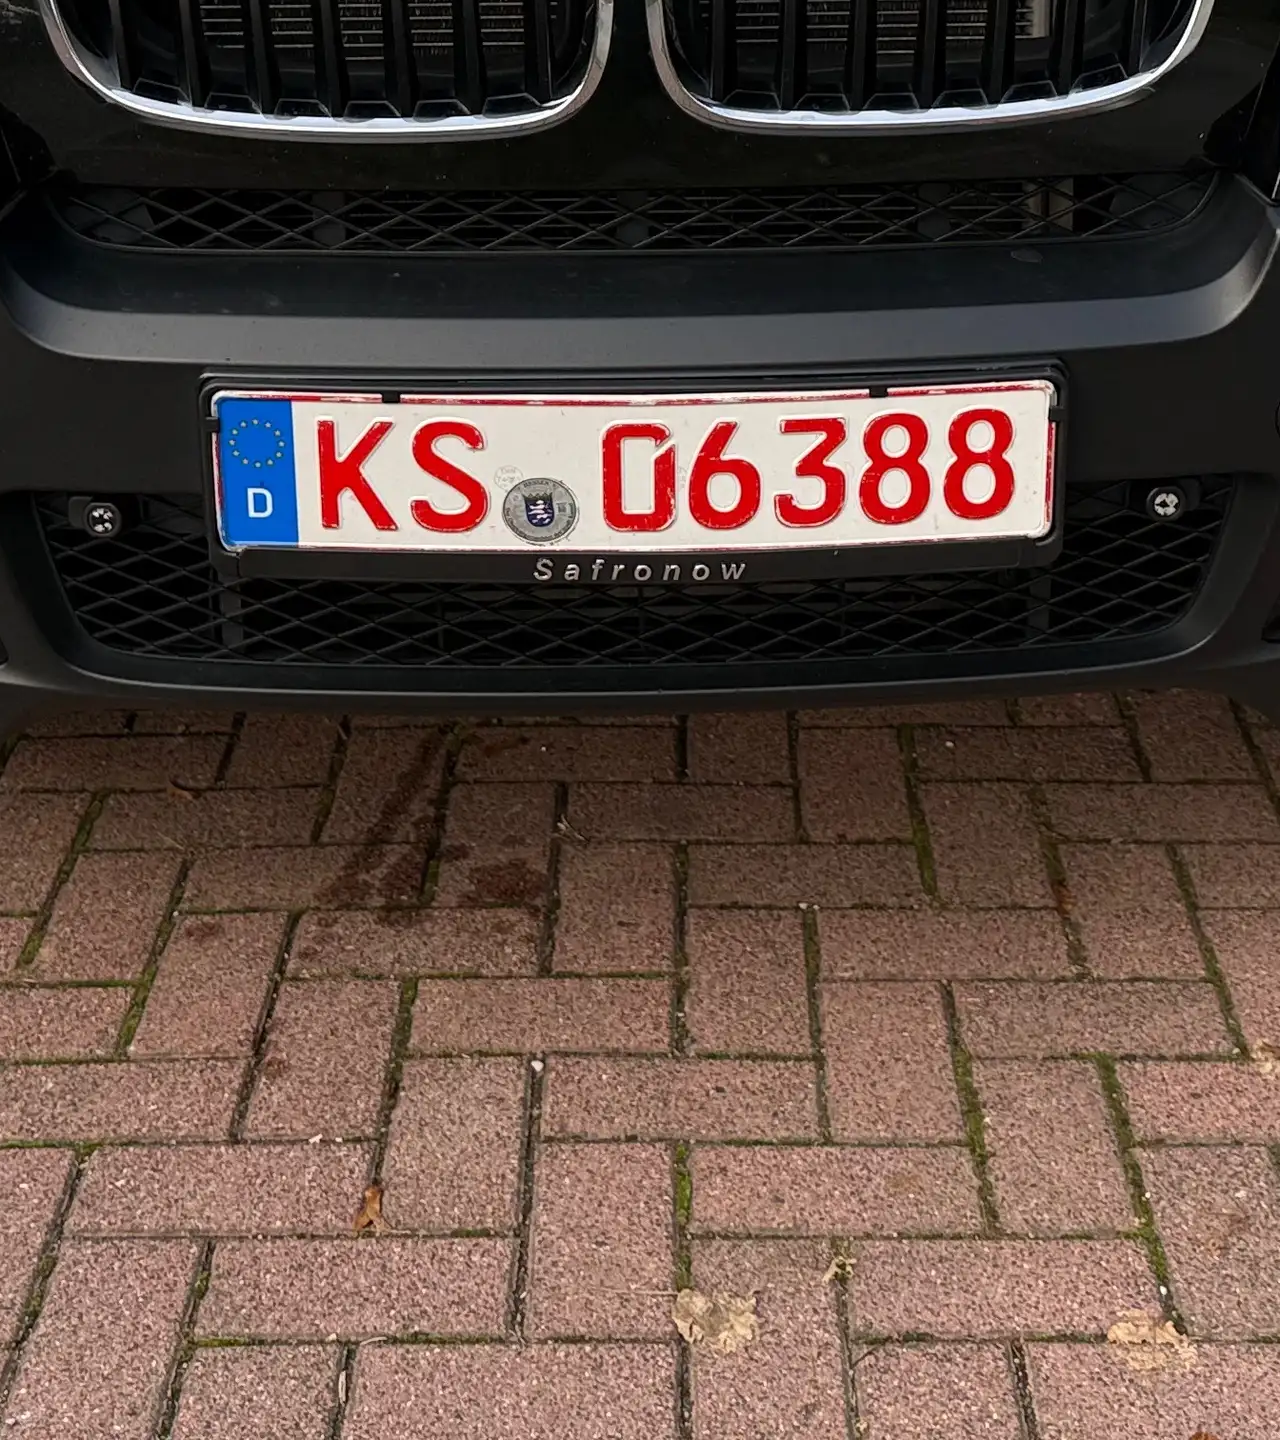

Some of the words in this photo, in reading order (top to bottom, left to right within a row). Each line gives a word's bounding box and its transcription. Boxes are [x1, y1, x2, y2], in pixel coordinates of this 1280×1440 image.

[316, 419, 489, 534] KS
[601, 407, 1016, 532] 06388
[247, 487, 274, 518] D
[533, 558, 747, 582] Safronow
